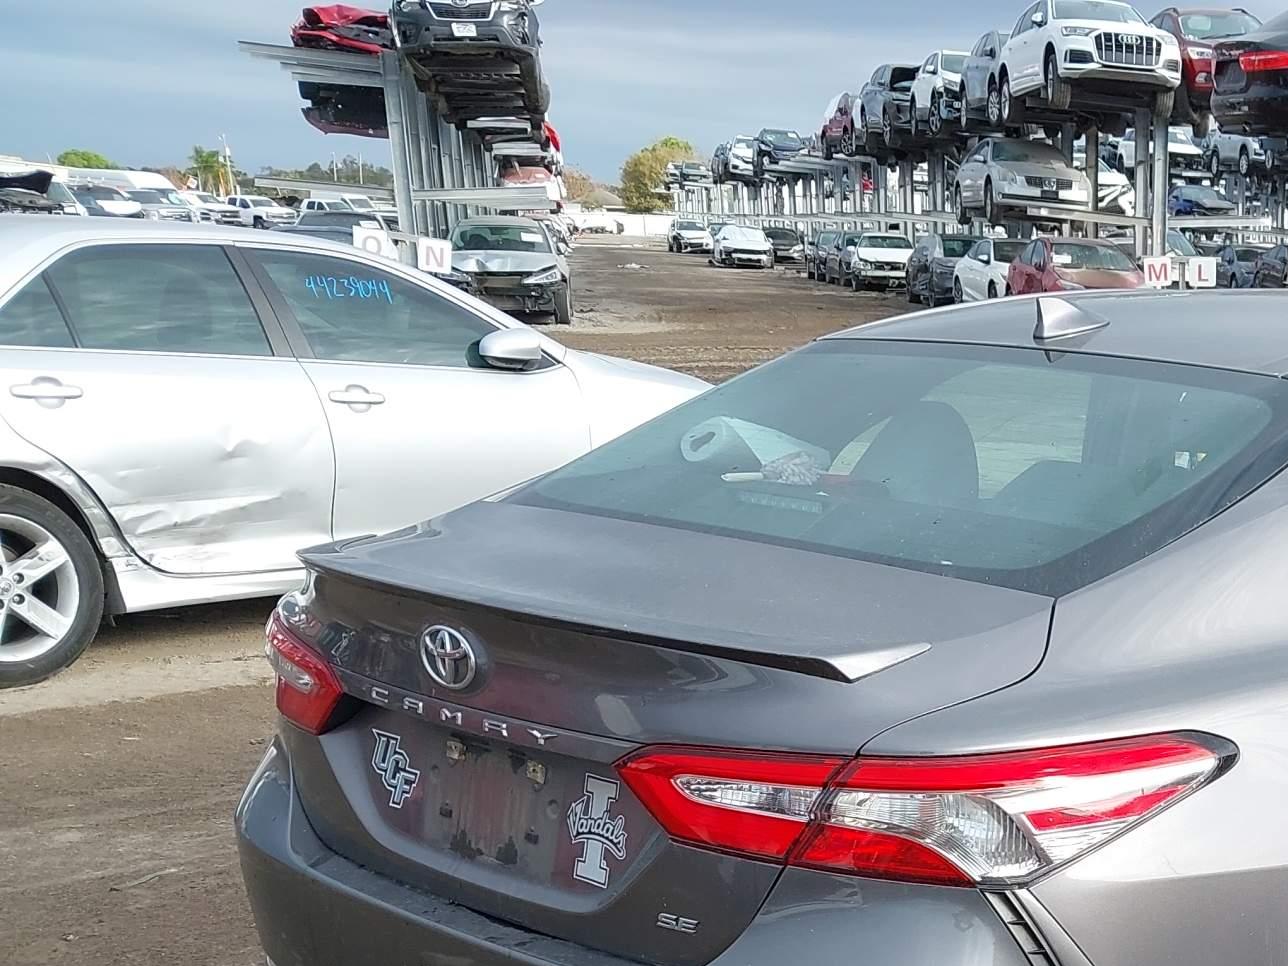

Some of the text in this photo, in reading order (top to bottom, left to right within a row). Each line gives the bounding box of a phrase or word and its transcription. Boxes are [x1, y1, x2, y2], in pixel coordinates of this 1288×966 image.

[425, 246, 444, 268] N
[1148, 263, 1168, 282] M
[1198, 263, 1209, 282] L
[371, 686, 559, 745] CAMRY
[372, 728, 420, 808] UCF
[567, 796, 628, 849] Vandals
[656, 912, 699, 934] SE
